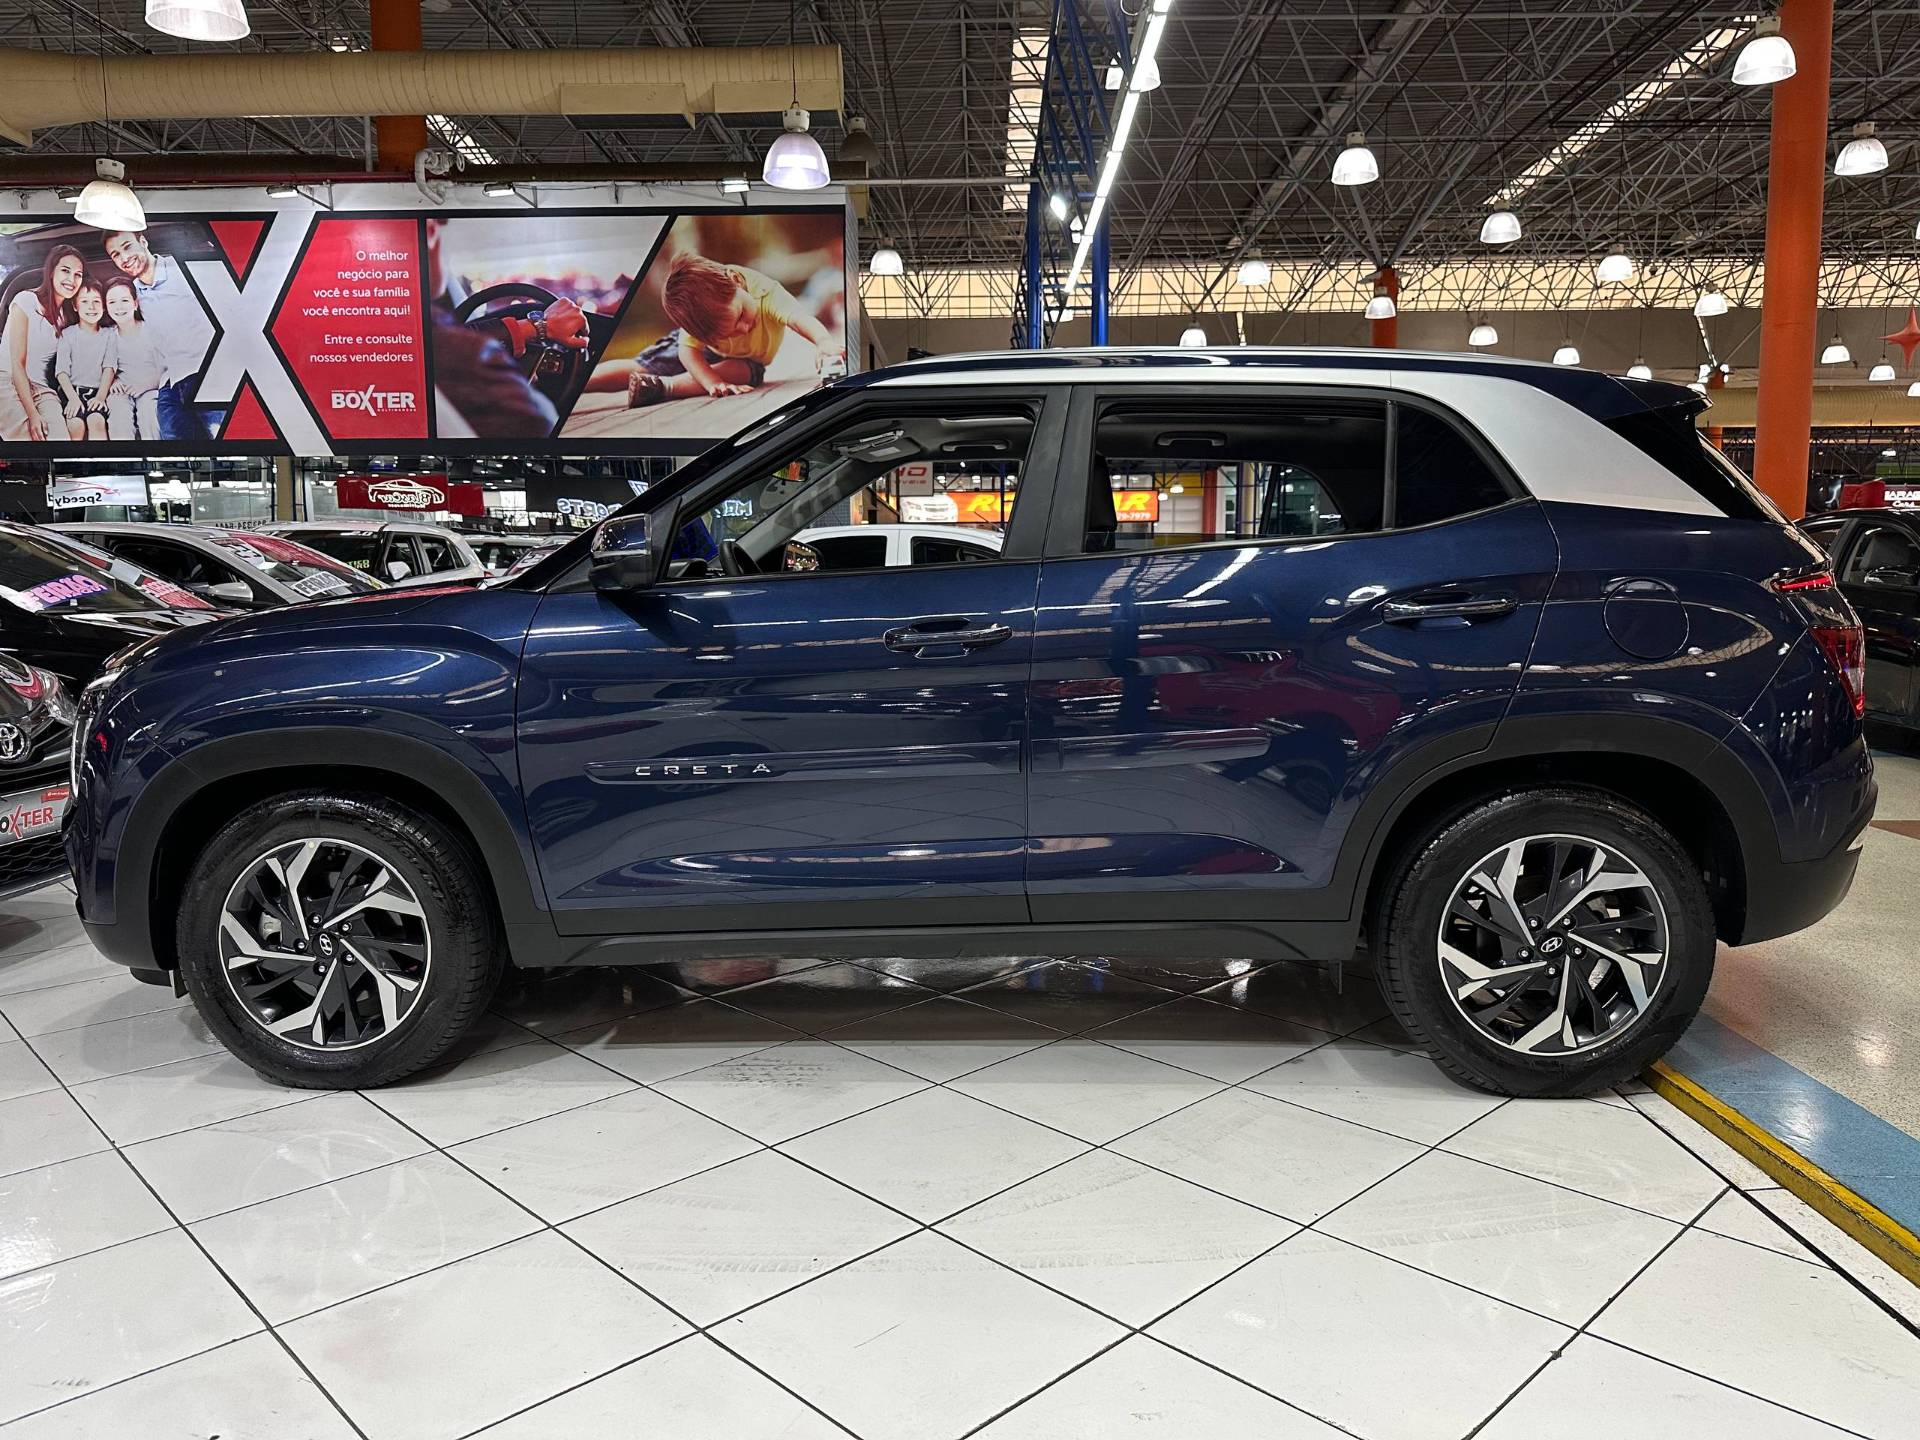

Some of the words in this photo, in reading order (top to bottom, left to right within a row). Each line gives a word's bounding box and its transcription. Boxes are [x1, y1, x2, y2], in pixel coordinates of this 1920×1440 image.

[356, 250, 366, 261] O
[369, 250, 408, 260] melhor
[337, 268, 382, 281] negócio
[385, 270, 409, 280] para
[313, 288, 340, 297] você
[343, 289, 350, 297] e
[352, 289, 371, 297] sua
[374, 287, 410, 297] família
[303, 306, 329, 316] você
[332, 306, 381, 315] encontra
[384, 305, 411, 317] aqui!
[324, 334, 353, 344] Entre
[356, 335, 363, 343] e
[365, 333, 413, 343] consulte
[310, 353, 347, 362] nossos
[349, 352, 414, 362] vendedores
[331, 384, 416, 416] BOXTER
[635, 763, 771, 776] CRETA
